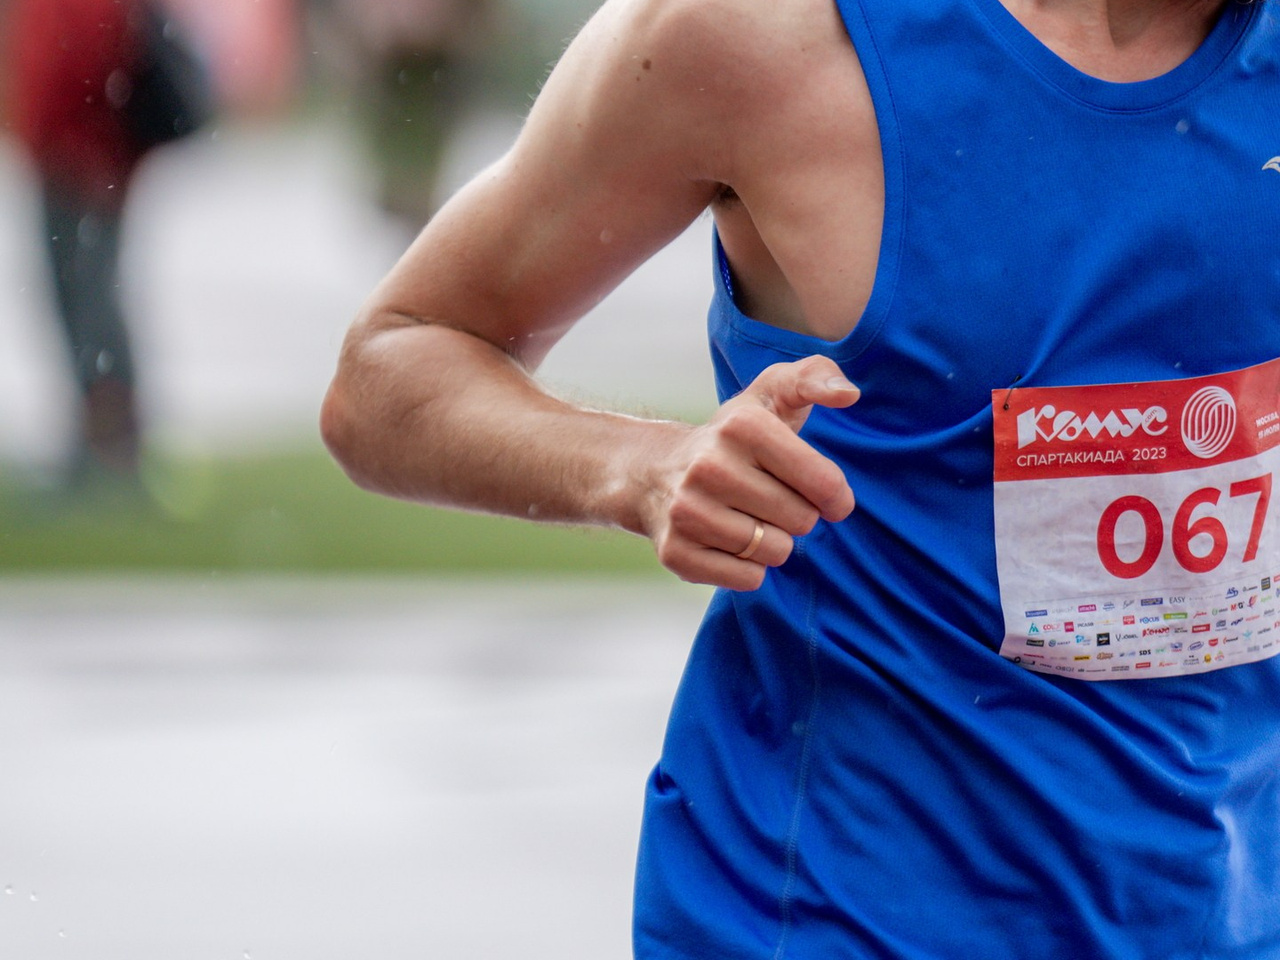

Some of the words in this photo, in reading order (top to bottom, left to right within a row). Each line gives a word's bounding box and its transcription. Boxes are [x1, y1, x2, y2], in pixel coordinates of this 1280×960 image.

[1016, 449, 1125, 467] СПАРТАКИАДА
[1132, 447, 1167, 461] 2023
[1096, 472, 1272, 579] 067
